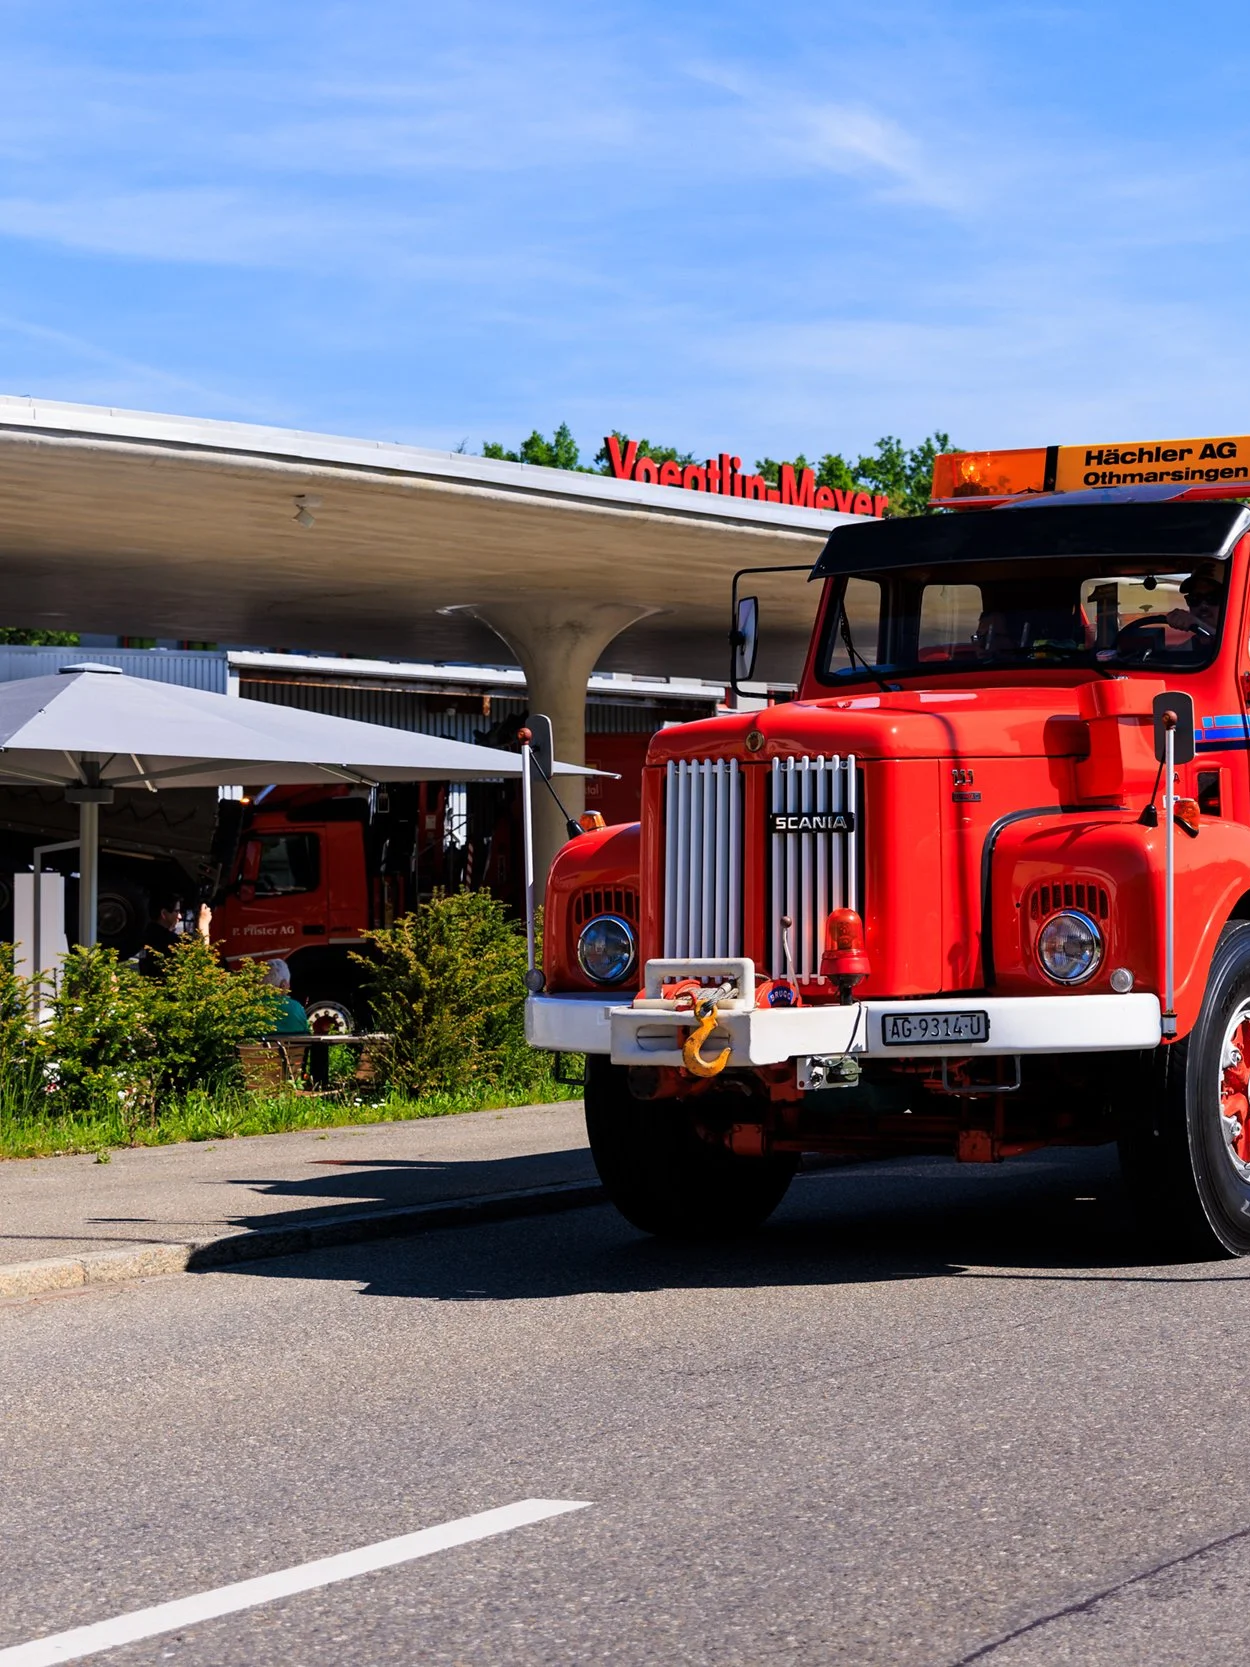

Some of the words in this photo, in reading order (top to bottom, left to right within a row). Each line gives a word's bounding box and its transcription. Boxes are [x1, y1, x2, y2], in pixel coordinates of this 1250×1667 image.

[1085, 446, 1193, 466] Hächler
[1199, 442, 1237, 460] AG
[1083, 467, 1249, 486] Othmarsingen
[775, 815, 848, 830] SCANIA
[280, 925, 295, 935] AG
